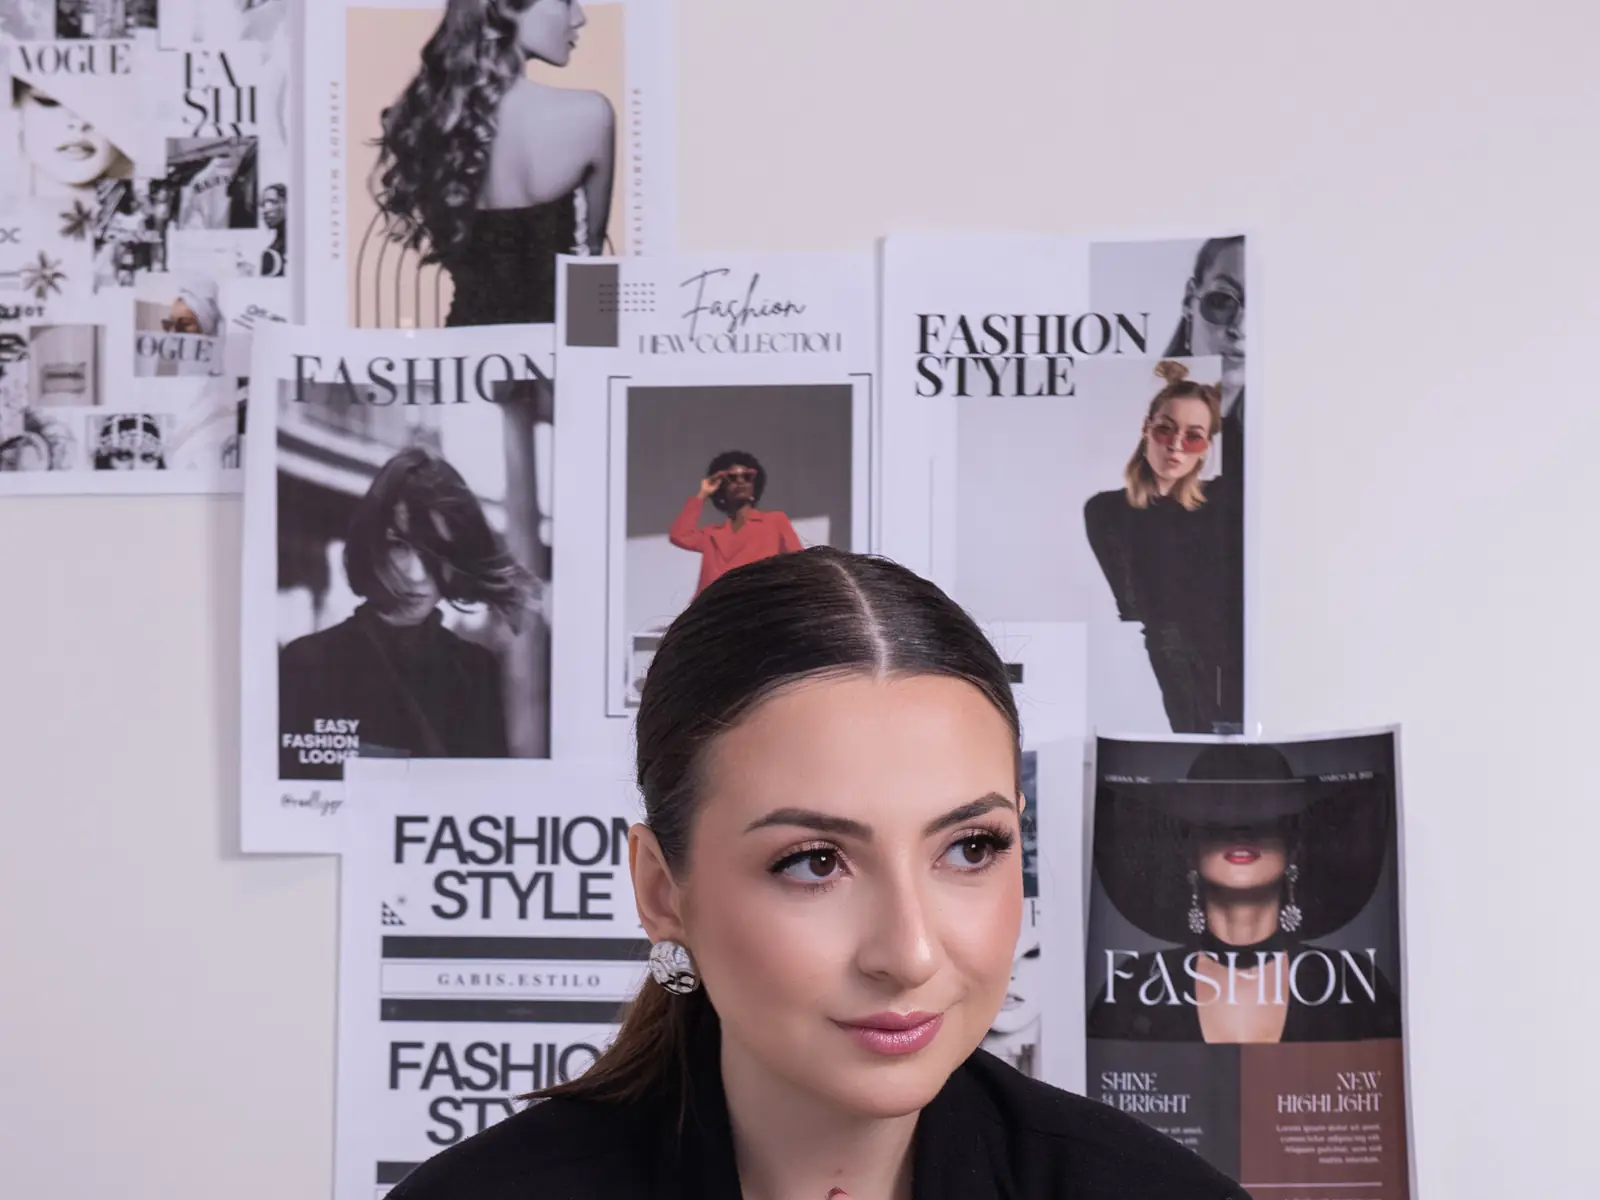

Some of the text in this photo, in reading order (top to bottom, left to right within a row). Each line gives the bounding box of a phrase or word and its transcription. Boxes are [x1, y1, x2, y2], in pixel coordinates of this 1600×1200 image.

[18, 44, 131, 75] VOGUE
[679, 267, 806, 343] Fashion
[694, 332, 843, 355] COLLECTION
[915, 312, 1151, 356] FASHION
[292, 352, 554, 406] FASHION
[915, 355, 1075, 398] STYLE
[314, 718, 360, 733] EASY
[282, 733, 360, 749] FASHION
[393, 814, 629, 867] FASHION
[431, 869, 614, 921] STYLE
[436, 973, 602, 988] GABIS.ESTILO
[1104, 948, 1377, 1007] FASHION
[1100, 1071, 1158, 1092] SHINE
[1336, 1071, 1382, 1091] NEW
[1118, 1093, 1191, 1114] BRIGHT
[1276, 1092, 1383, 1114] HIGHLIGHT
